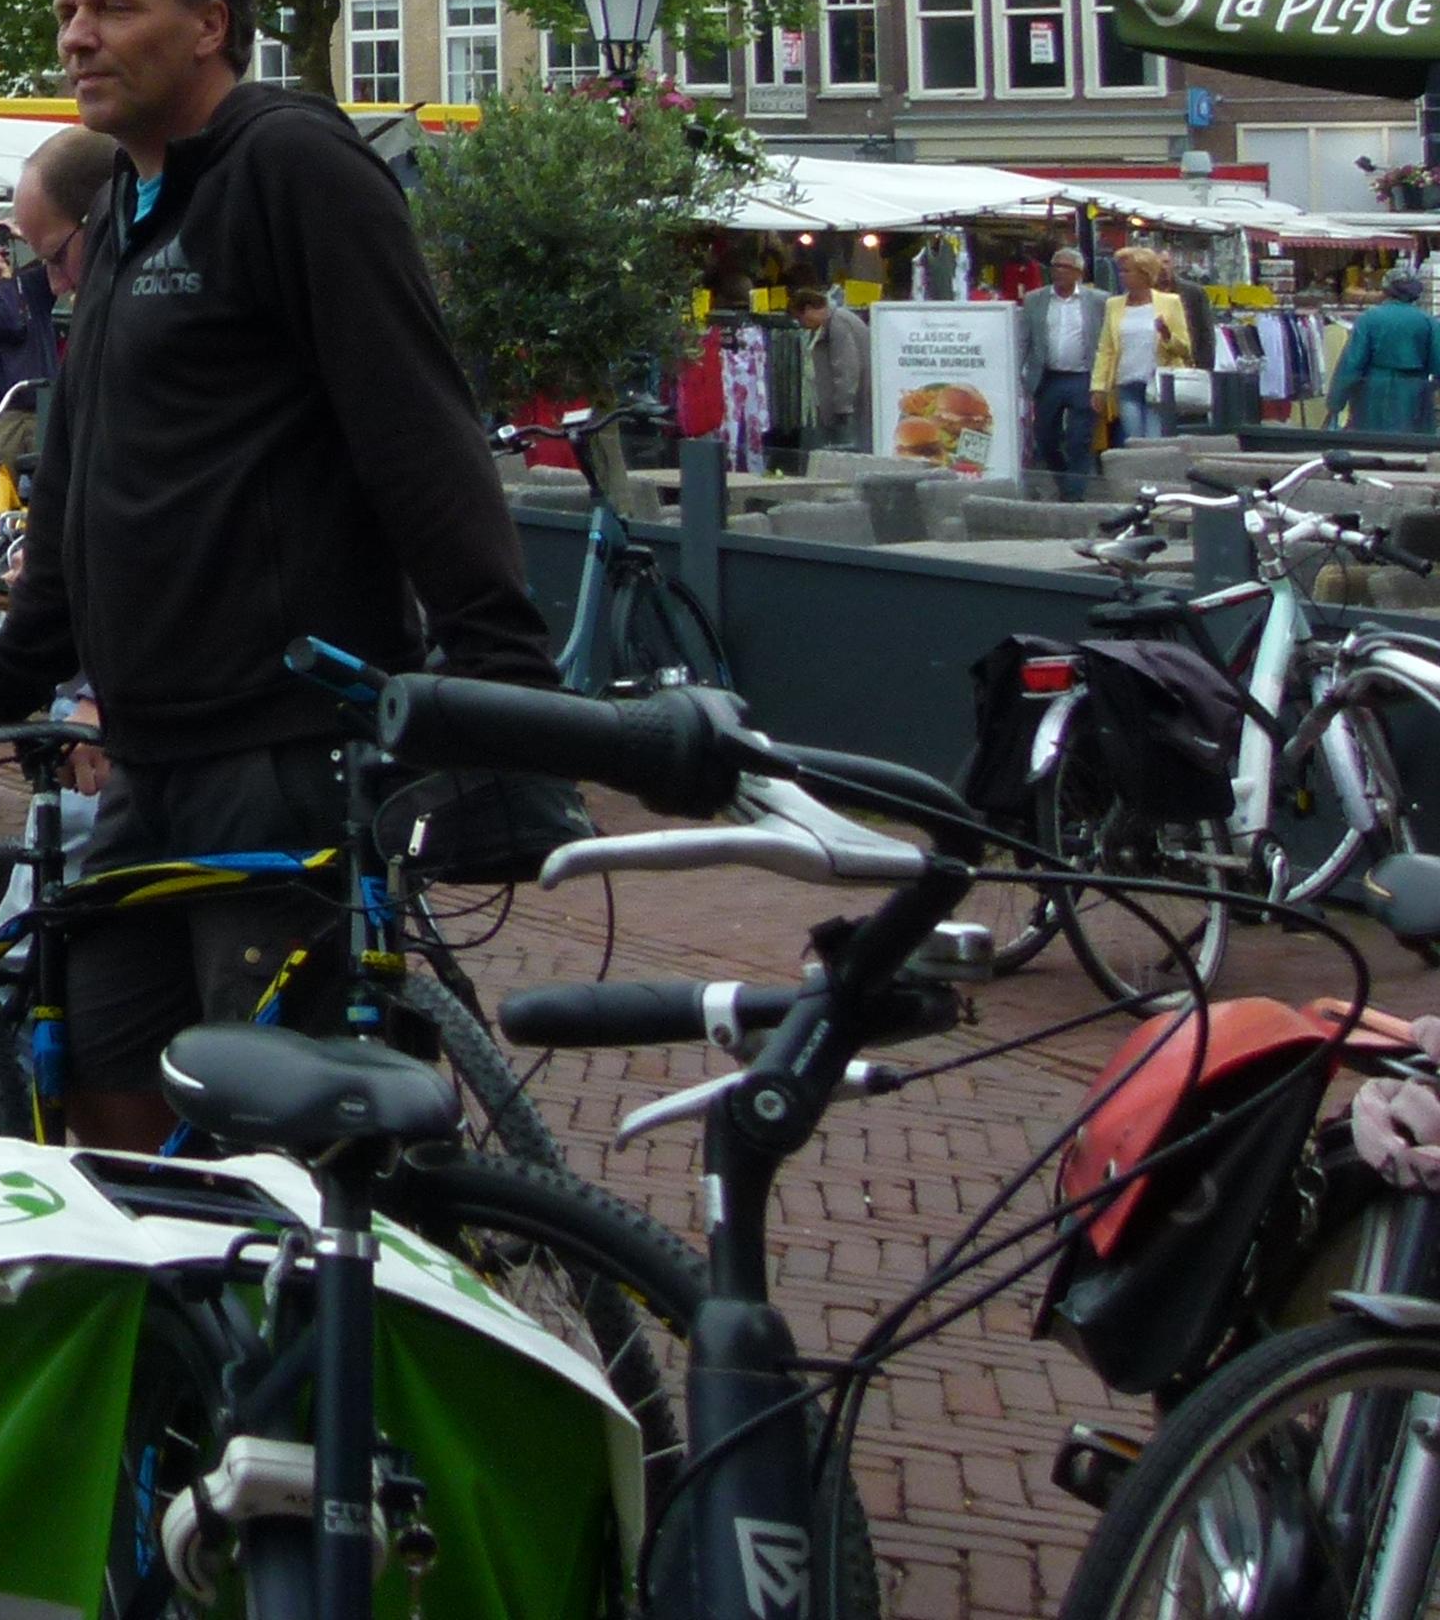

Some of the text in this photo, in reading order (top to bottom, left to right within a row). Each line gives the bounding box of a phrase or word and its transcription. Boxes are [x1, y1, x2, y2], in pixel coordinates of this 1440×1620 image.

[131, 271, 203, 297] adidas
[908, 332, 955, 342] CLASSIC
[901, 344, 982, 355] VEGETARISCHE
[898, 356, 987, 368] QUINOA BURGER
